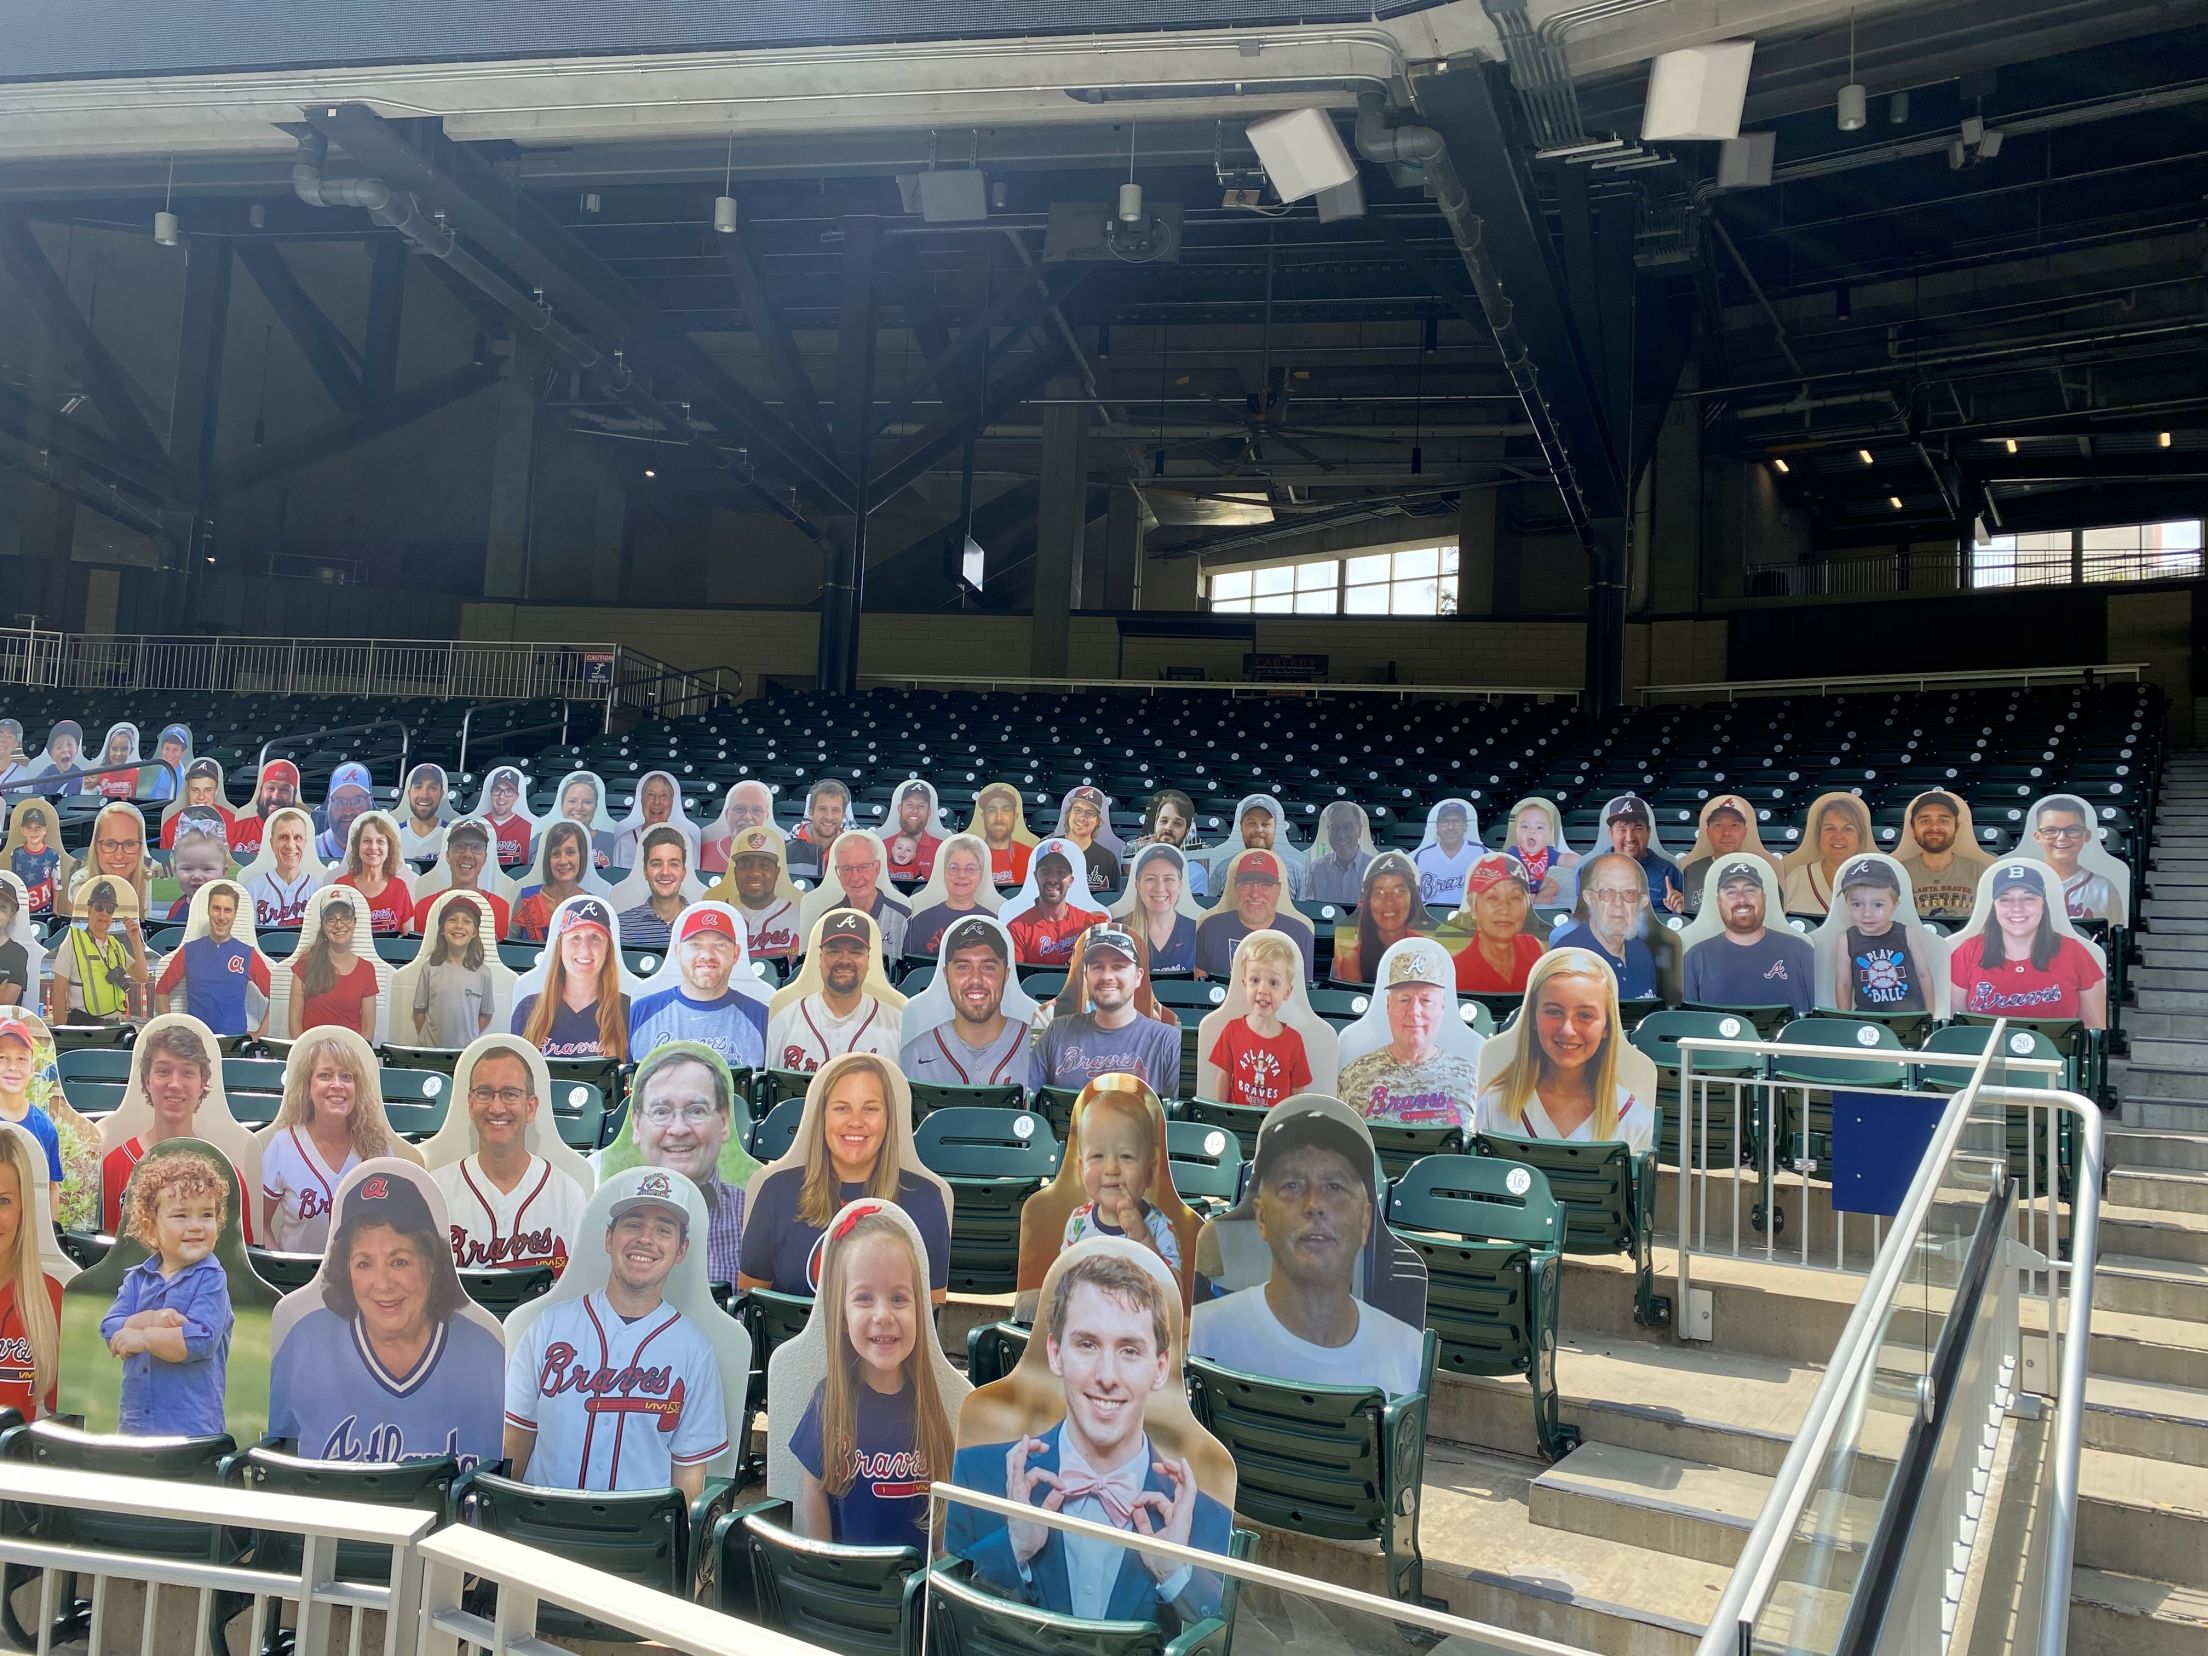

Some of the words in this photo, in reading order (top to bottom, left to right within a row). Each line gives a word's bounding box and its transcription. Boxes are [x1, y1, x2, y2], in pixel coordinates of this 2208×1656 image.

[586, 654, 614, 662] CAUTION
[1618, 800, 1633, 814] A
[1729, 863, 1749, 874] A
[1850, 861, 1870, 875] A
[2008, 866, 2025, 879] B
[29, 885, 51, 907] SA
[1912, 886, 1938, 894] LANTA
[257, 898, 306, 924] Brav
[576, 901, 598, 916] A
[836, 915, 856, 929] A
[1403, 954, 1425, 974] A
[1866, 949, 1894, 961] PLAY
[1763, 959, 1789, 980] A
[1872, 987, 1904, 1003] BALL
[1969, 981, 2062, 1011] Braves
[1056, 1046, 1137, 1076] Braves
[1239, 1048, 1281, 1077] ATLANTA
[1238, 1079, 1278, 1099] BRAVES
[1365, 1085, 1448, 1117] Braves
[361, 1177, 389, 1200] a
[539, 1341, 673, 1398] Braves
